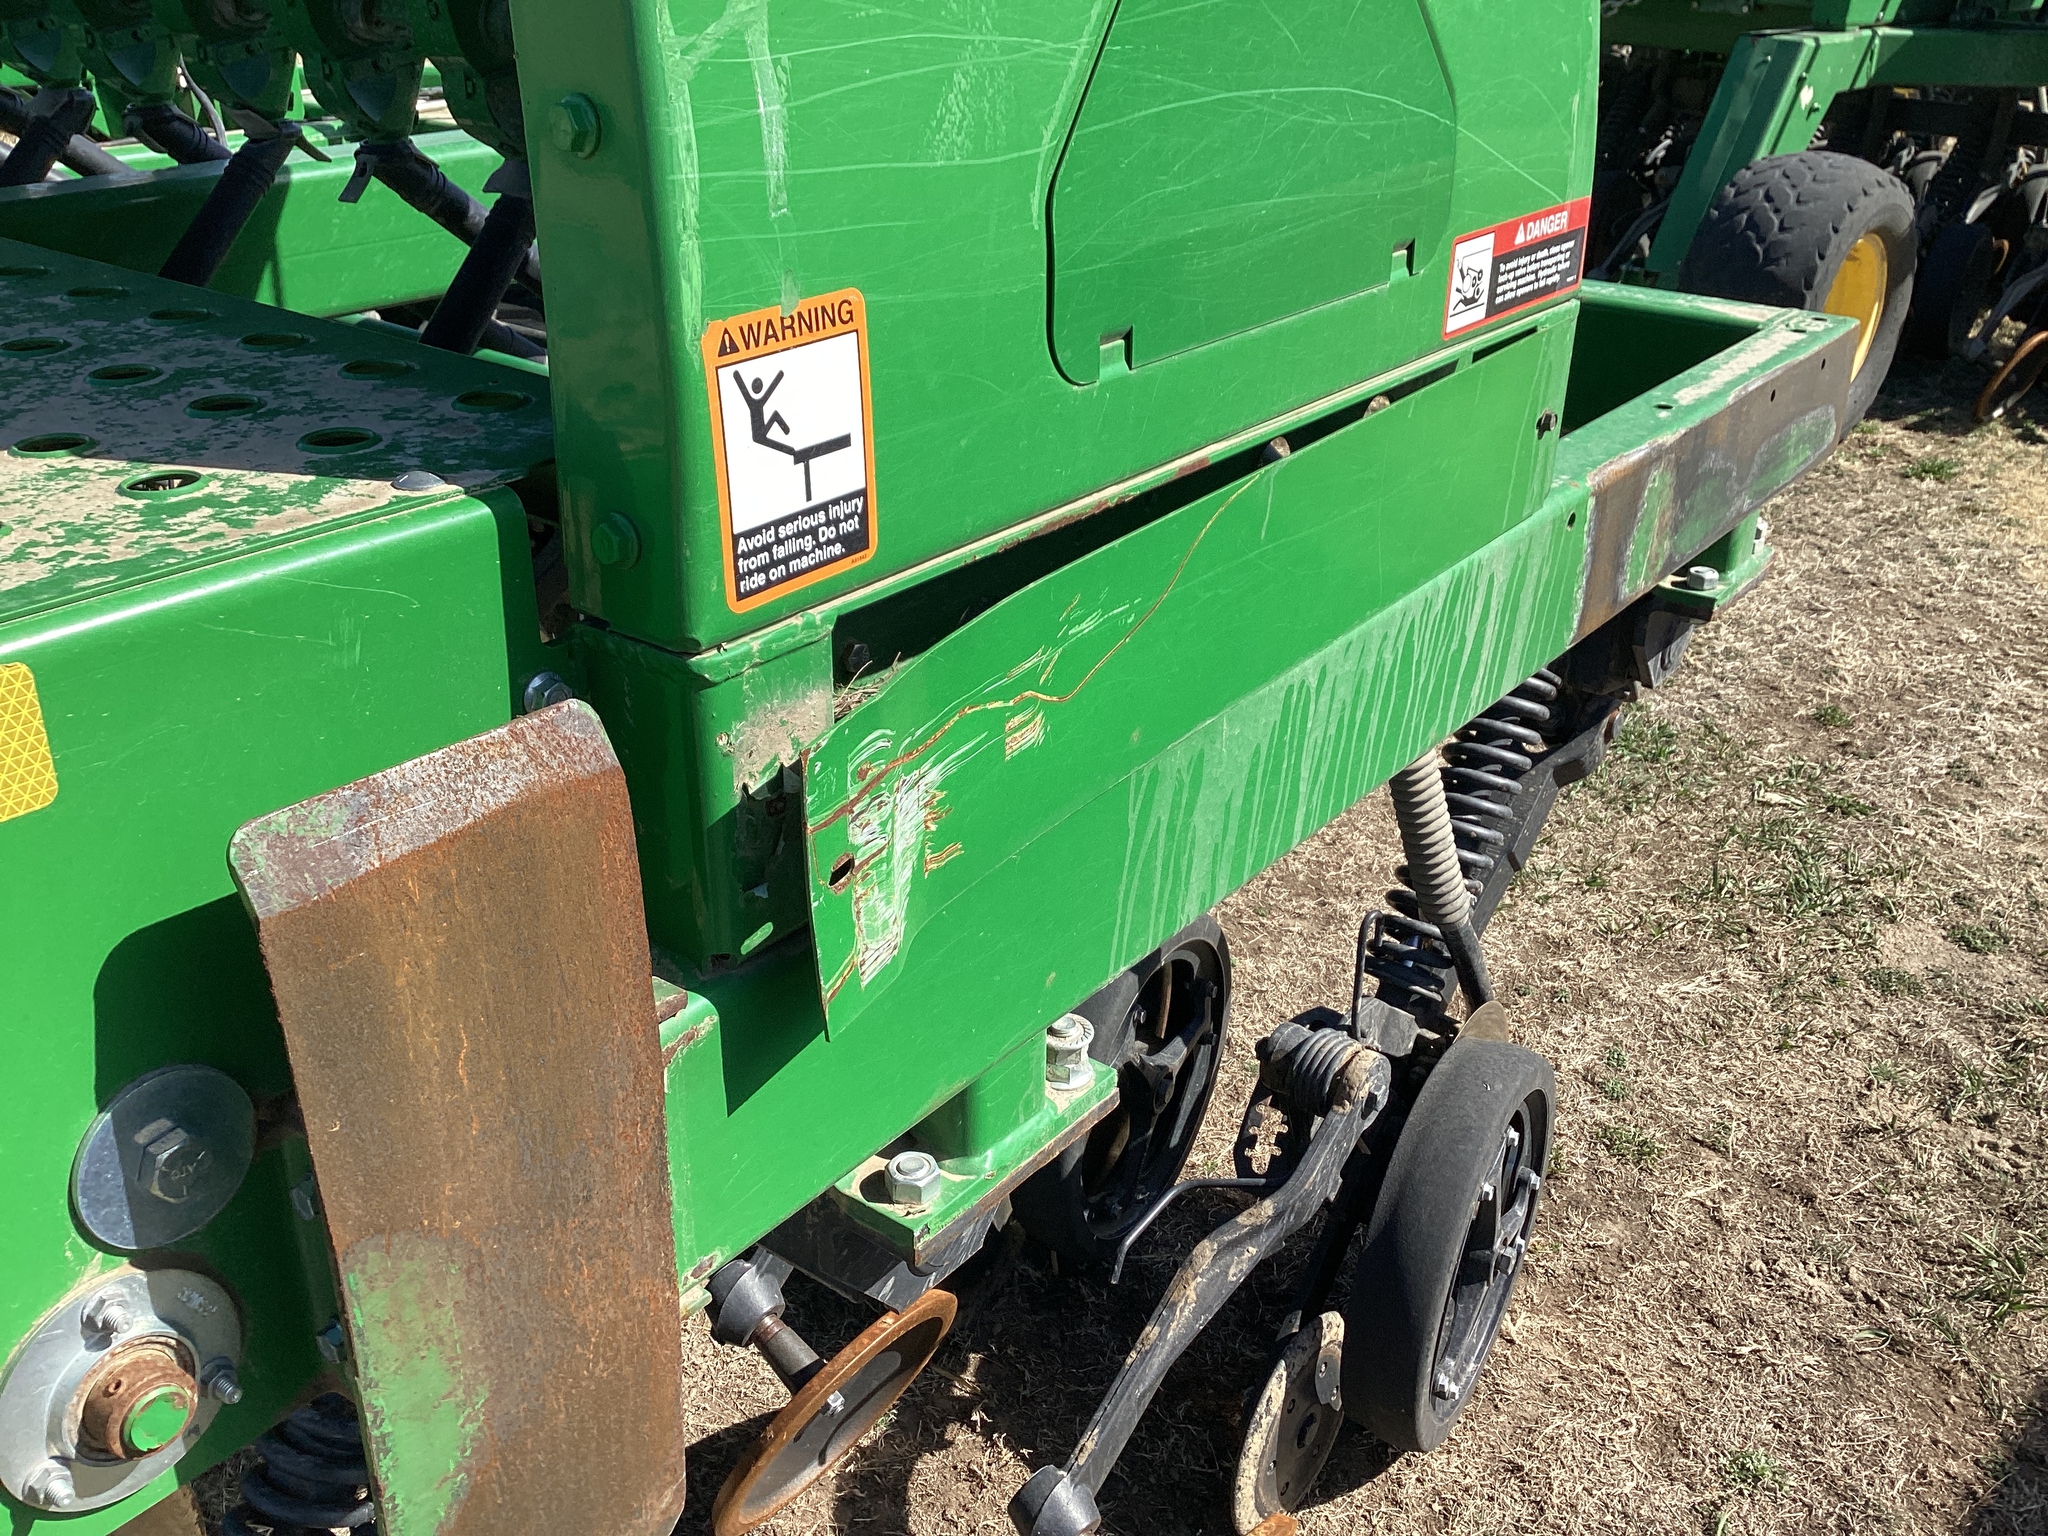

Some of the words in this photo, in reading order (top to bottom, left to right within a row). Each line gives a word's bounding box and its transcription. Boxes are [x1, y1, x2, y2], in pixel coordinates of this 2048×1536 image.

[1526, 210, 1568, 242] DANGER
[738, 299, 854, 350] WARNING
[737, 526, 775, 554] Avoid
[778, 510, 826, 538] serious
[829, 496, 864, 519] injury
[738, 551, 770, 573] from
[772, 534, 816, 560] falling.
[818, 526, 836, 542] Do
[839, 515, 859, 535] not
[740, 573, 766, 593] ride
[769, 566, 786, 580] on
[789, 542, 846, 573] machine.
